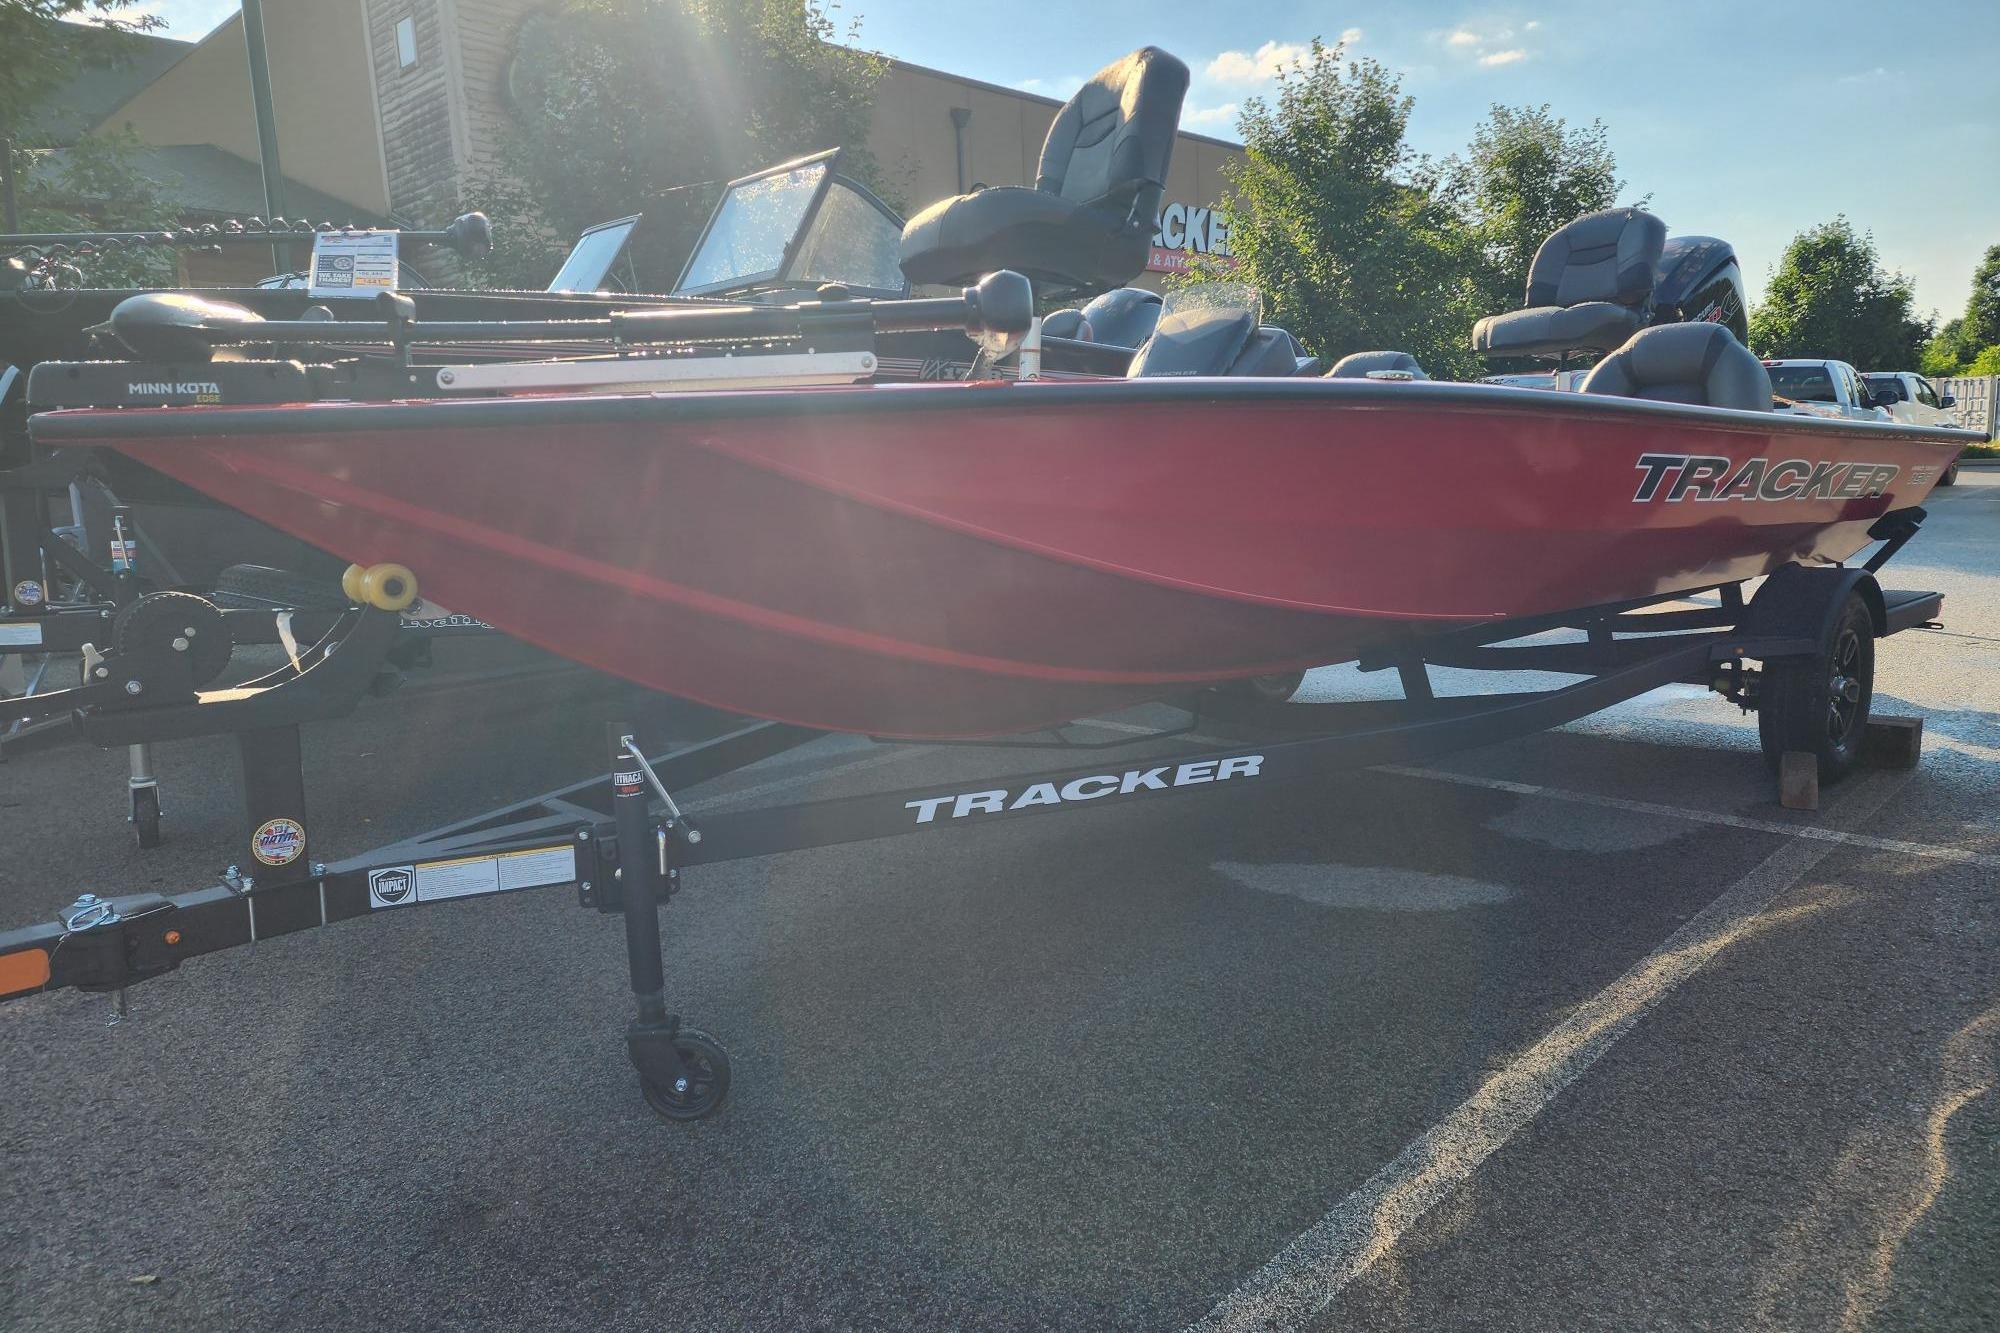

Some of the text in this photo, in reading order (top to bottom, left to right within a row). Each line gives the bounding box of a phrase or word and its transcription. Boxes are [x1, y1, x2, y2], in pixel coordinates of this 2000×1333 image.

[1153, 253, 1162, 266] &
[128, 382, 220, 395] MINN KOTA
[196, 394, 221, 403] EDGE
[1632, 453, 1900, 503] TRACKER
[616, 772, 642, 784] ITHACA
[905, 755, 1264, 823] TRACKER
[378, 878, 407, 894] IMPACT
